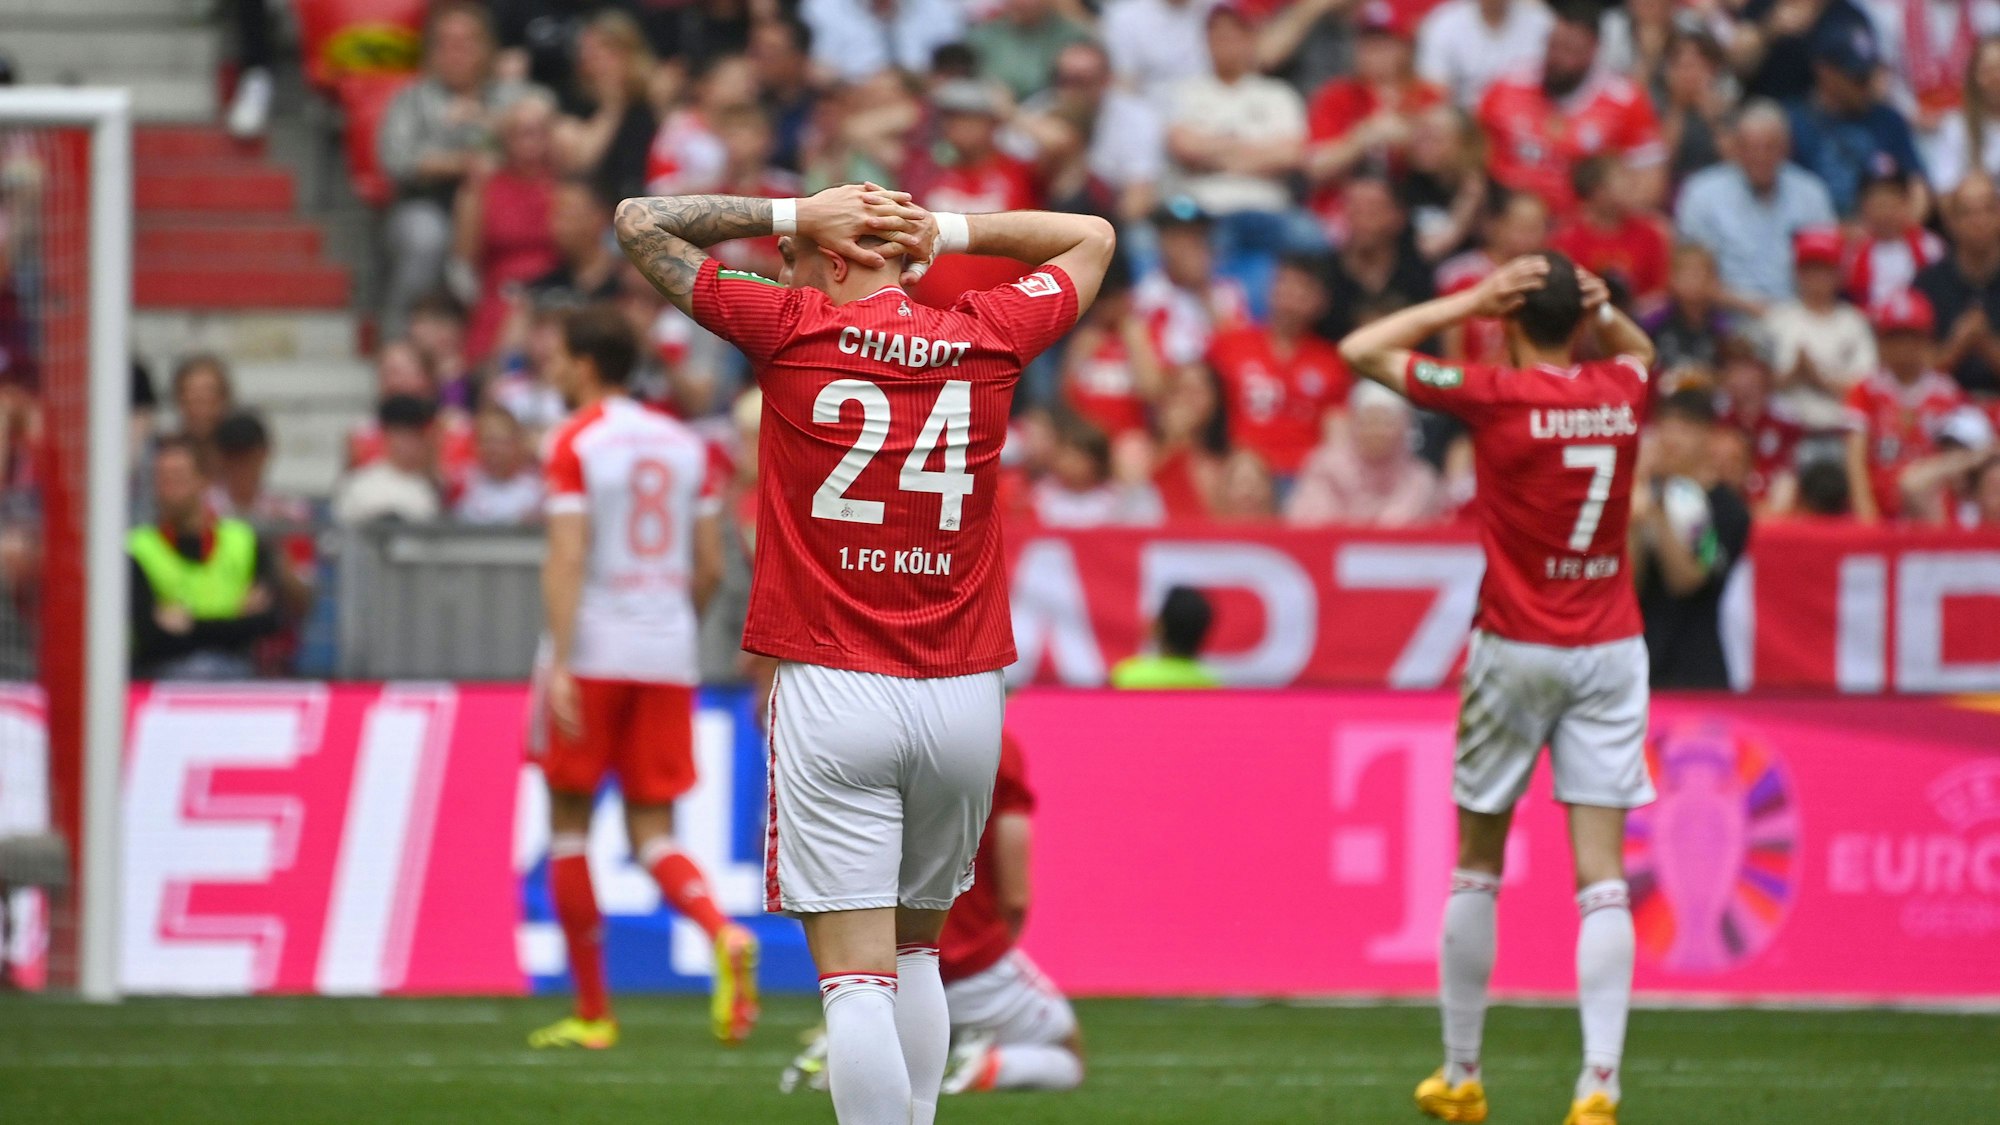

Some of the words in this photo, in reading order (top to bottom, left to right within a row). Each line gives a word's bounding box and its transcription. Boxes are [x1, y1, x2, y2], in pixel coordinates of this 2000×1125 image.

[838, 326, 972, 368] CHABOT
[811, 378, 975, 532] 24
[1562, 444, 1617, 552] 7
[628, 457, 674, 562] 8
[893, 546, 952, 576] KÖLN
